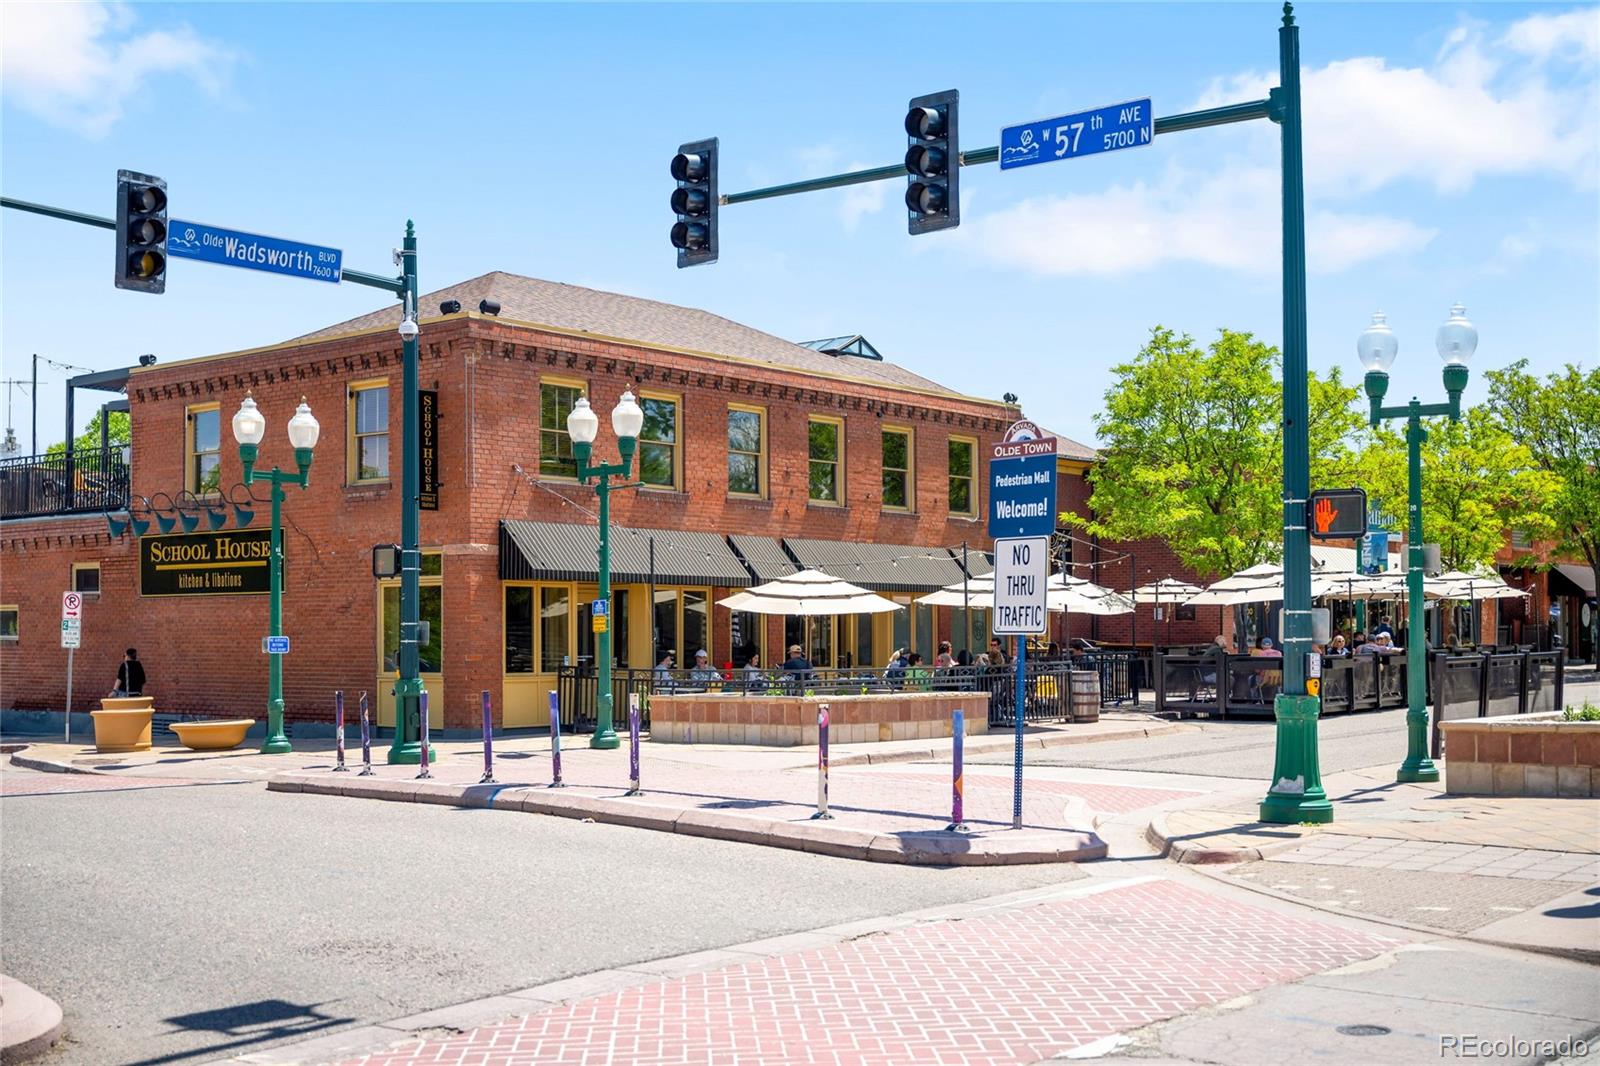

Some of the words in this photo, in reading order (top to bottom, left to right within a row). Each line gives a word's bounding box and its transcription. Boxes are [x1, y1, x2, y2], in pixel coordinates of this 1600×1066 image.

[1042, 128, 1051, 141] W
[1055, 122, 1084, 158] 57
[1091, 115, 1102, 130] th
[1119, 106, 1141, 124] AVE
[1104, 130, 1135, 150] 5700
[1140, 126, 1150, 142] N
[203, 232, 224, 248] Olde
[225, 236, 313, 272] Wadsworth
[319, 251, 336, 264] BLVD
[313, 265, 331, 278] 7600
[1012, 423, 1036, 435] ARVADA
[994, 446, 1021, 457] OLDE
[1023, 442, 1052, 454] TOWN
[995, 473, 1032, 487] Pedestrian
[1034, 471, 1050, 484] Mall
[996, 497, 1048, 519] Welcome!
[150, 542, 210, 562] SCHOOL
[215, 538, 271, 559] HOUSE
[1012, 545, 1030, 566] NO
[178, 574, 203, 589] kitchen
[205, 573, 210, 587] &
[212, 572, 242, 587] libations
[1007, 575, 1035, 596] THRU
[999, 605, 1042, 626] TRAFFIC
